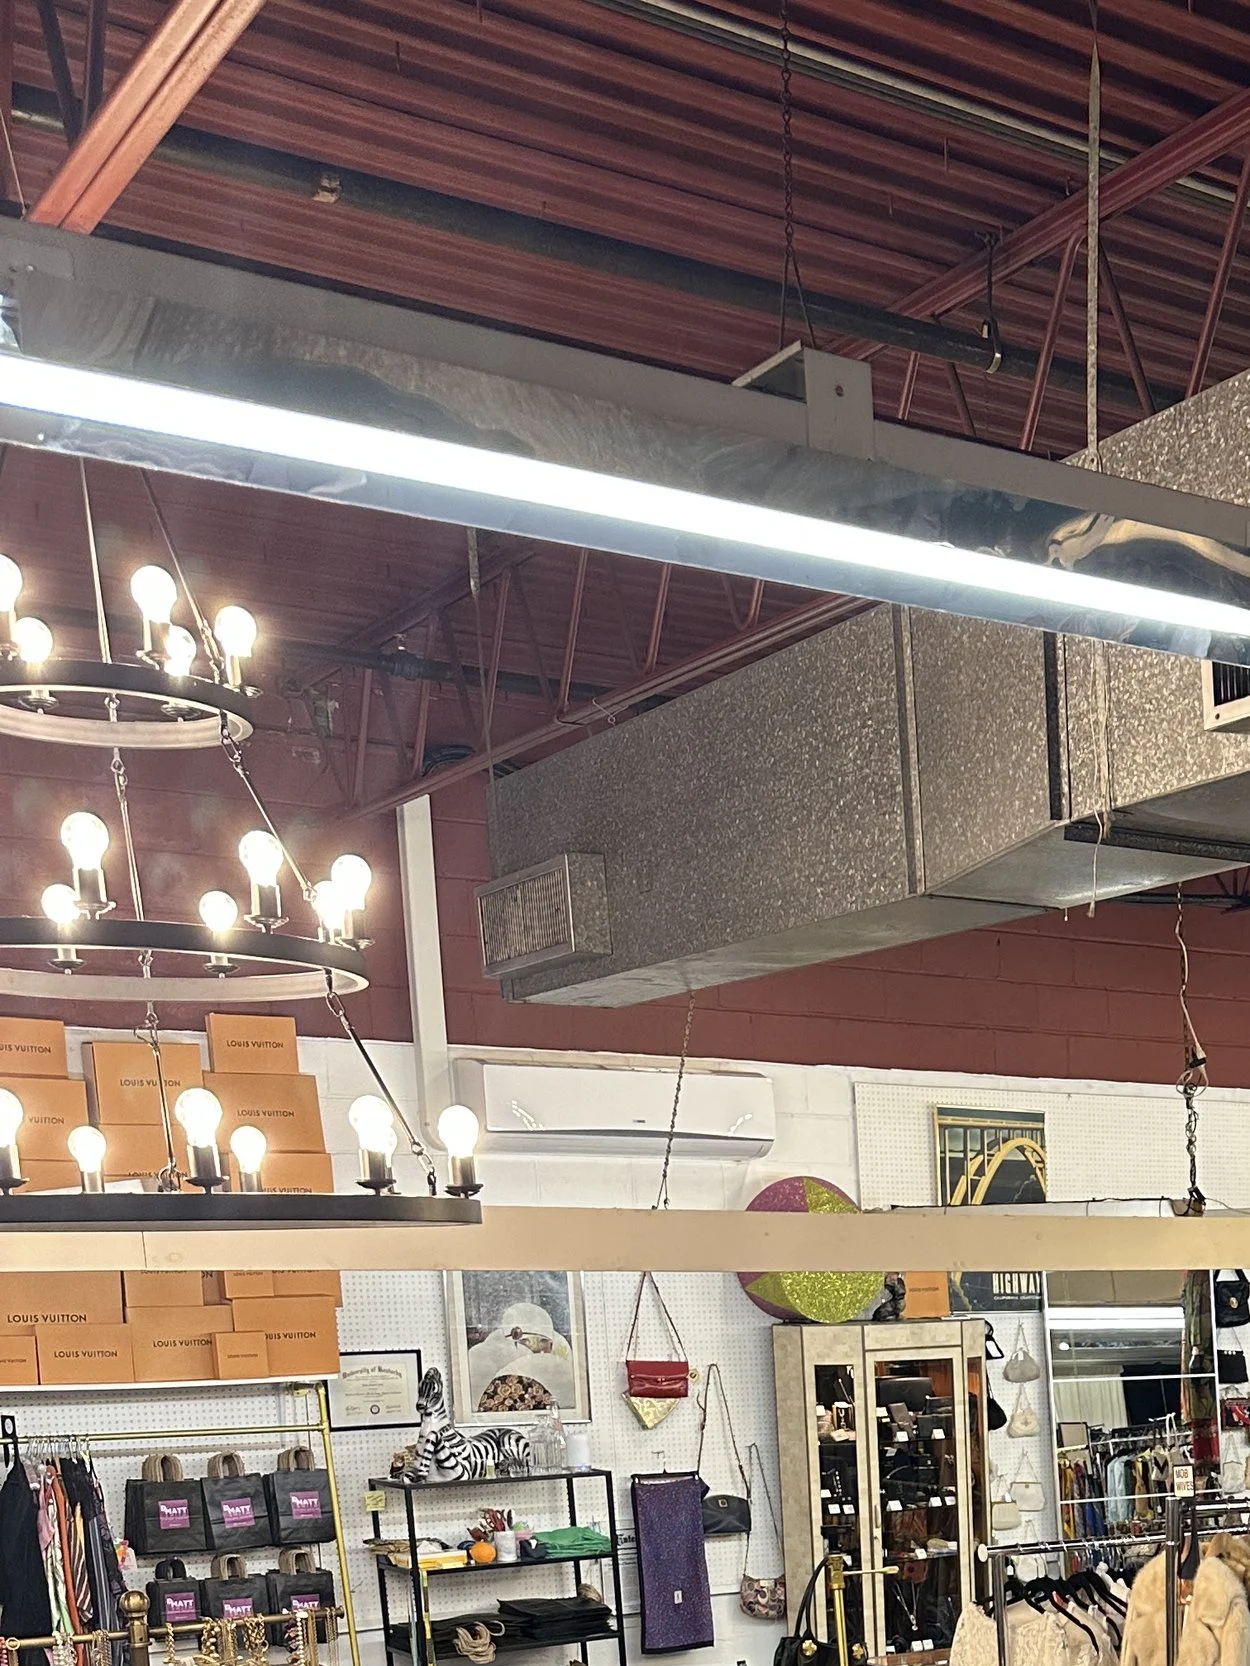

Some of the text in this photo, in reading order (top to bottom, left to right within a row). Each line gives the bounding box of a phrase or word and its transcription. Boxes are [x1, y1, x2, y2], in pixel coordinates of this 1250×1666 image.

[0, 1043, 52, 1054] UIS VUITTON
[226, 1040, 284, 1049] LOUIS VUITTON
[120, 1079, 144, 1087] LOUIS
[237, 1109, 295, 1118] LOUIS VUITTON
[28, 1116, 65, 1125] VUITTON
[7, 1314, 87, 1323] LOUIS VUITTON
[283, 1331, 317, 1340] VUITTON
[153, 1338, 213, 1348] LOUIS VUITTON
[54, 1350, 118, 1358] LOUIS VUITTON
